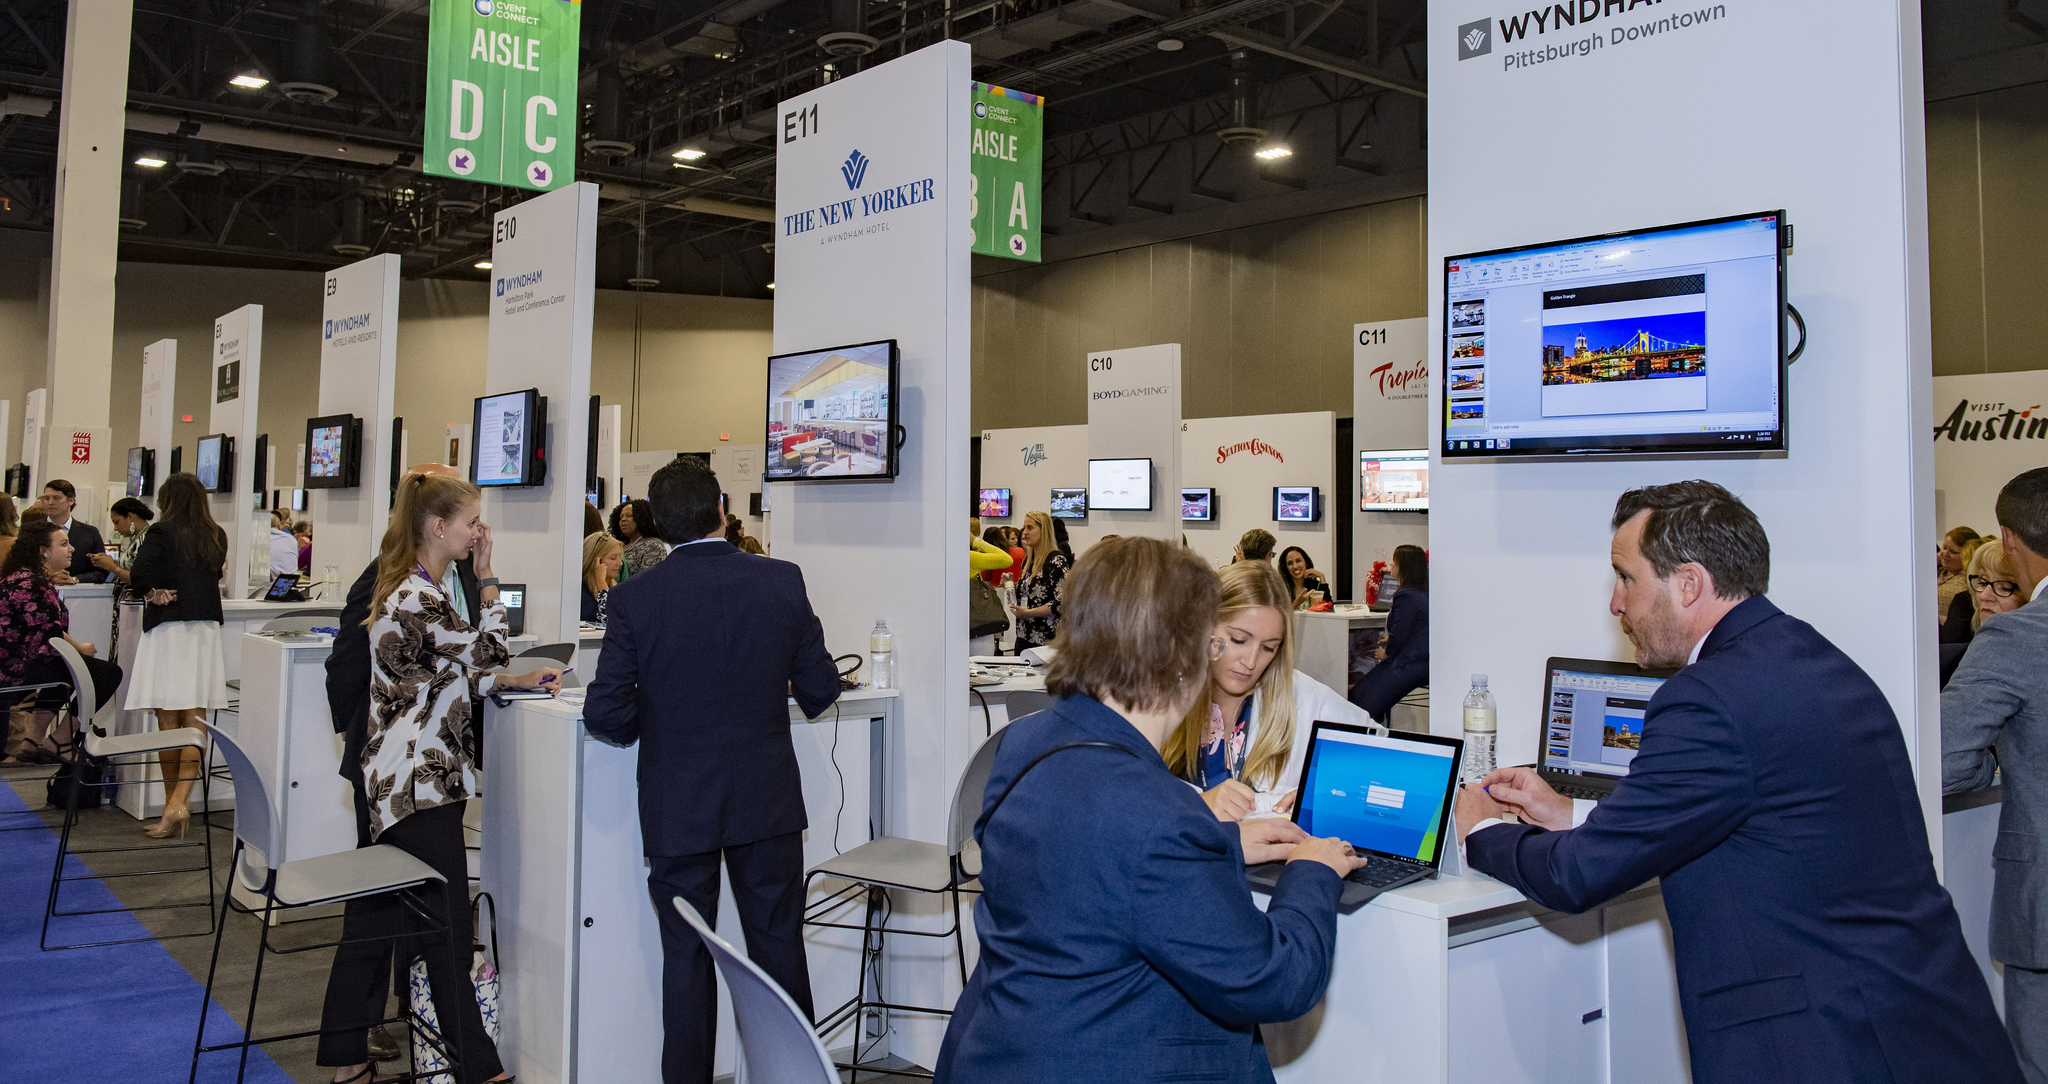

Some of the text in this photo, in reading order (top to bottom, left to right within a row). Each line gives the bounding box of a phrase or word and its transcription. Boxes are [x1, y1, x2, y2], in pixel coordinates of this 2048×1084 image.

[496, 2, 527, 15] CVENT
[496, 11, 538, 25] CONNECT
[1499, 0, 1662, 43] WYNDH
[1504, 4, 1726, 71] Pittsburgh Downtown
[471, 28, 540, 71] AISLE
[450, 79, 483, 141] D
[988, 105, 1009, 116] CVENT
[988, 112, 1017, 124] CONNECT
[525, 95, 557, 153] C
[784, 103, 818, 144] E11
[972, 128, 1018, 162] AISLE
[784, 178, 935, 237] THE NEW YORKER
[1008, 181, 1028, 230] A
[496, 216, 517, 243] E10
[827, 229, 864, 243] WYNDHAM
[866, 222, 890, 235] HOTEL
[326, 277, 337, 296] E9
[506, 269, 543, 291] WYNDHAM
[505, 290, 534, 305] Hamilton Park
[505, 294, 566, 316] Hotel and Conference Center
[333, 312, 370, 334] WYNDHAM
[332, 330, 377, 347] HOTELS AND RESORTS
[1359, 328, 1386, 345] C11
[1091, 357, 1112, 371] C10
[1093, 386, 1168, 400] BOYDGAMING
[1971, 403, 2005, 412] VISIT
[1933, 398, 2048, 442] Austin
[1021, 445, 1048, 467] Vegas
[1216, 438, 1284, 464] STATION CASINOS
